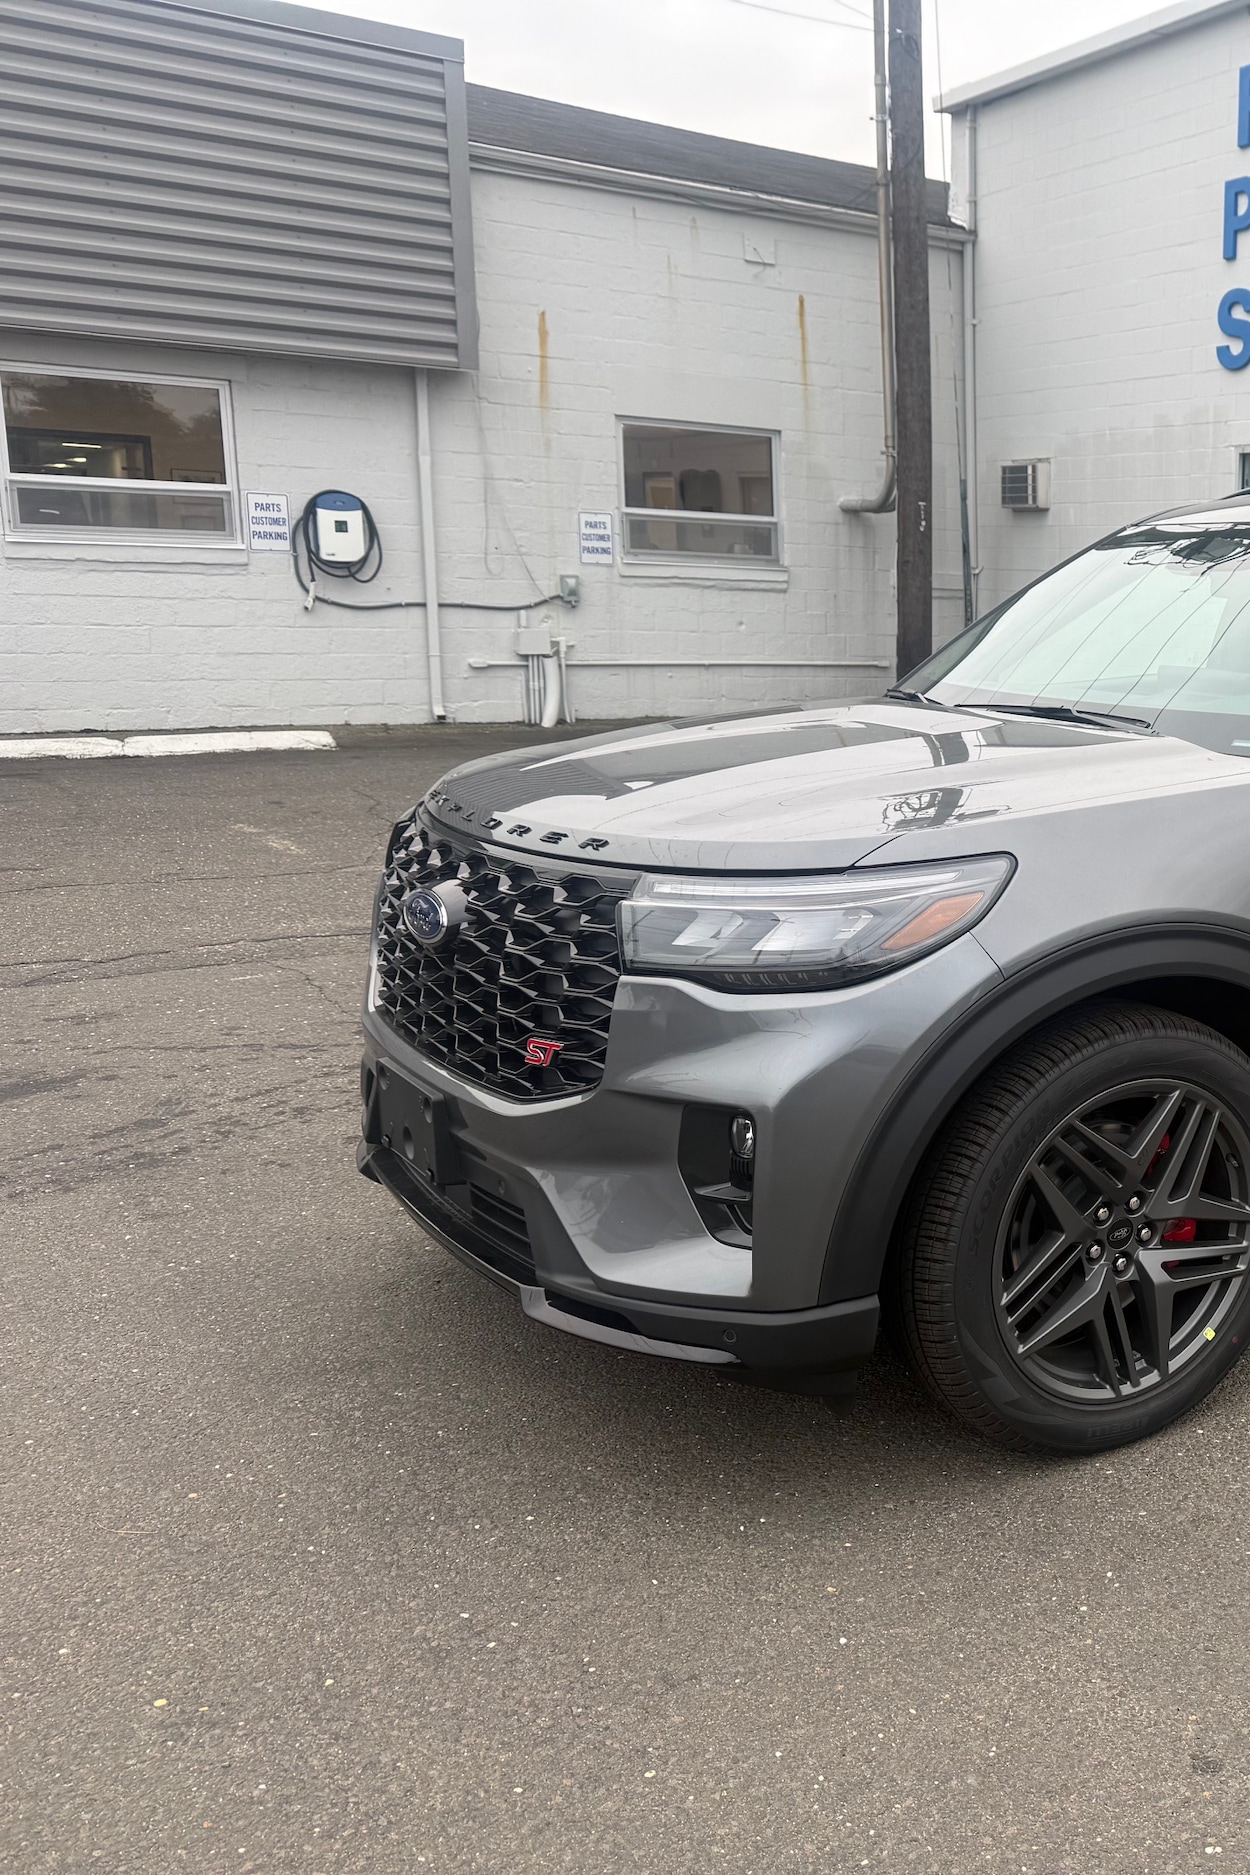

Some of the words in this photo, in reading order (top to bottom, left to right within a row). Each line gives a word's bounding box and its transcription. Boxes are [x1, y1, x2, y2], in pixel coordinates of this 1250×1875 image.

[254, 502, 282, 513] PARTS
[251, 515, 287, 527] CUSTOMER
[584, 520, 607, 530] PARTS
[252, 530, 288, 541] PARKING
[581, 532, 611, 542] CUSTOMER
[581, 545, 611, 555] PARKING
[429, 789, 610, 852] EXPLORER
[525, 1038, 564, 1067] ST
